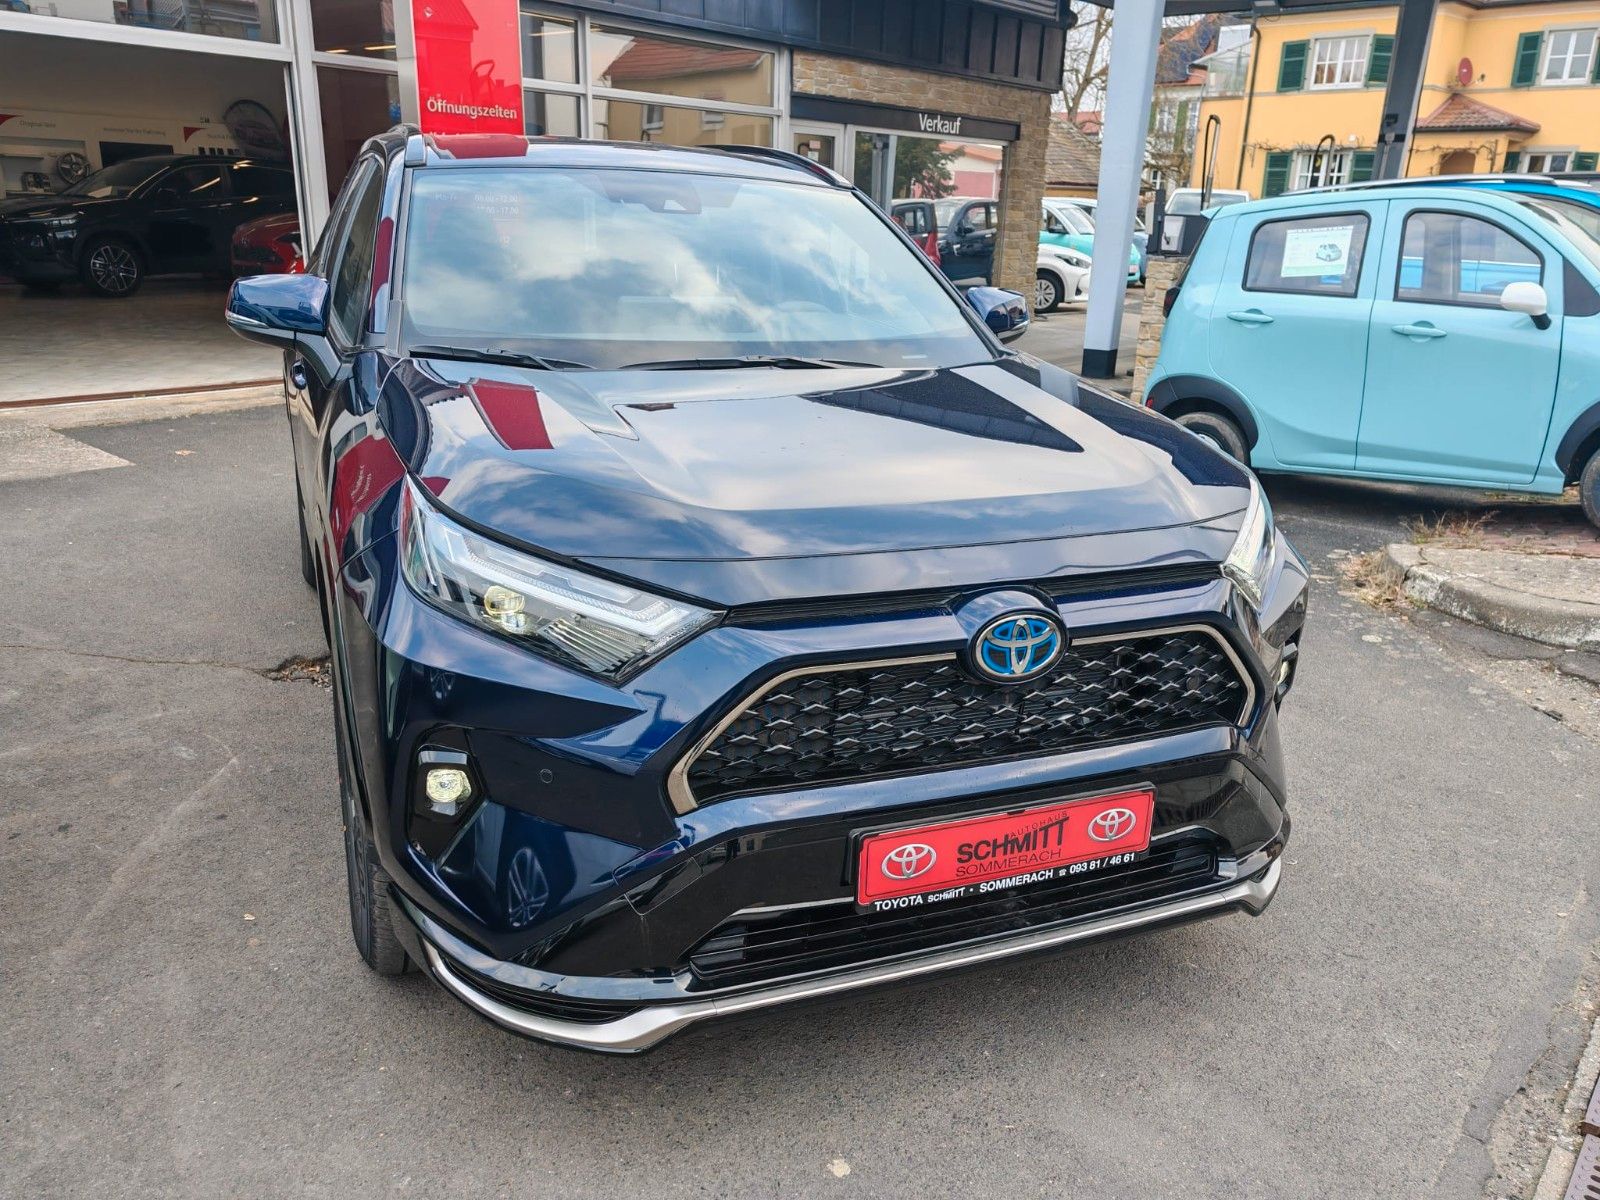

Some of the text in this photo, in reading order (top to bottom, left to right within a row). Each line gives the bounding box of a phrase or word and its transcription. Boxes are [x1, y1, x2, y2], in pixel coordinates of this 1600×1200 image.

[427, 96, 518, 119] Öffnungszeiten
[919, 113, 962, 135] Verkauf
[1011, 811, 1068, 837] AUTOHAUS
[957, 816, 1070, 864] SCHMITT
[955, 848, 1062, 877] SOMMERACH
[874, 895, 924, 911] TOYOTA
[927, 887, 965, 903] SCHMITT
[979, 869, 1054, 892] SOMMERACH
[1069, 862, 1088, 874] 093
[1089, 860, 1101, 871] 81
[1123, 852, 1135, 863] 61
